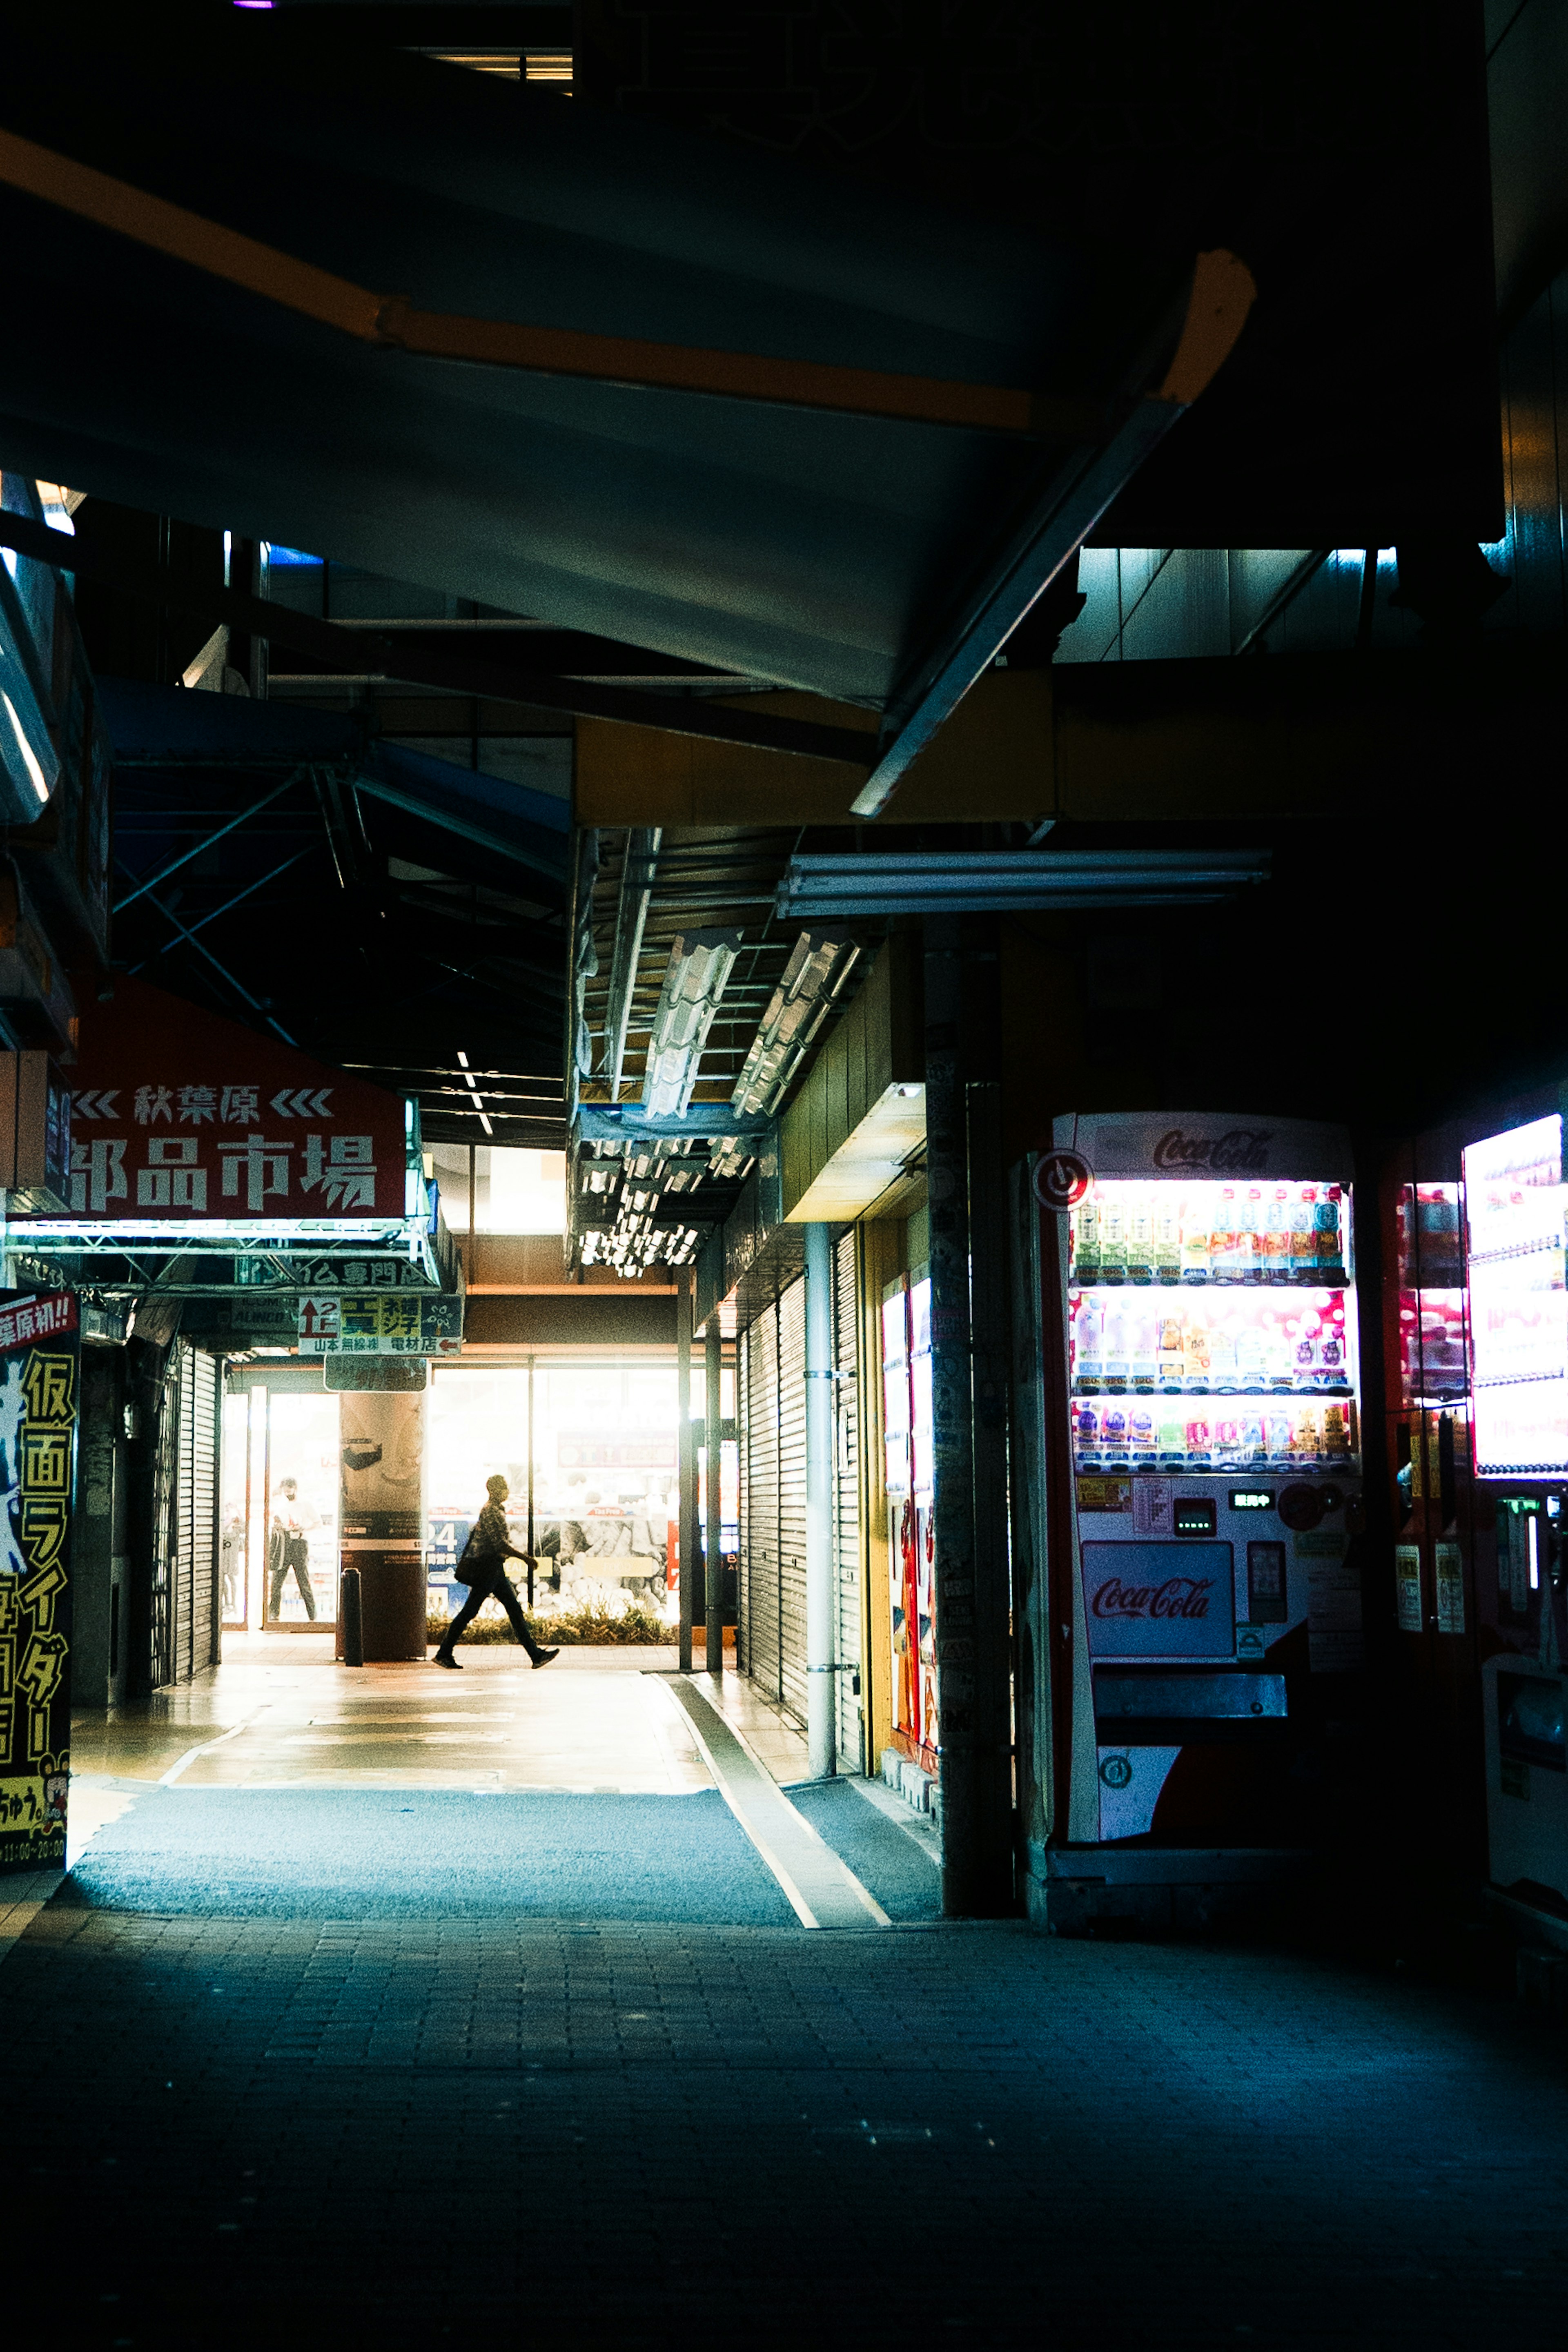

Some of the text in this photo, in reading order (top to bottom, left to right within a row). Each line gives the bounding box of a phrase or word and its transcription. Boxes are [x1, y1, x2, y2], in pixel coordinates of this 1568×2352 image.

[134, 1085, 261, 1125] 秋葉原
[1154, 1130, 1274, 1169] Coca-Cola
[391, 1336, 437, 1352] 電材店
[18, 1351, 74, 1754] 仮面ライダー
[1092, 1577, 1215, 1619] Coca-Cola
